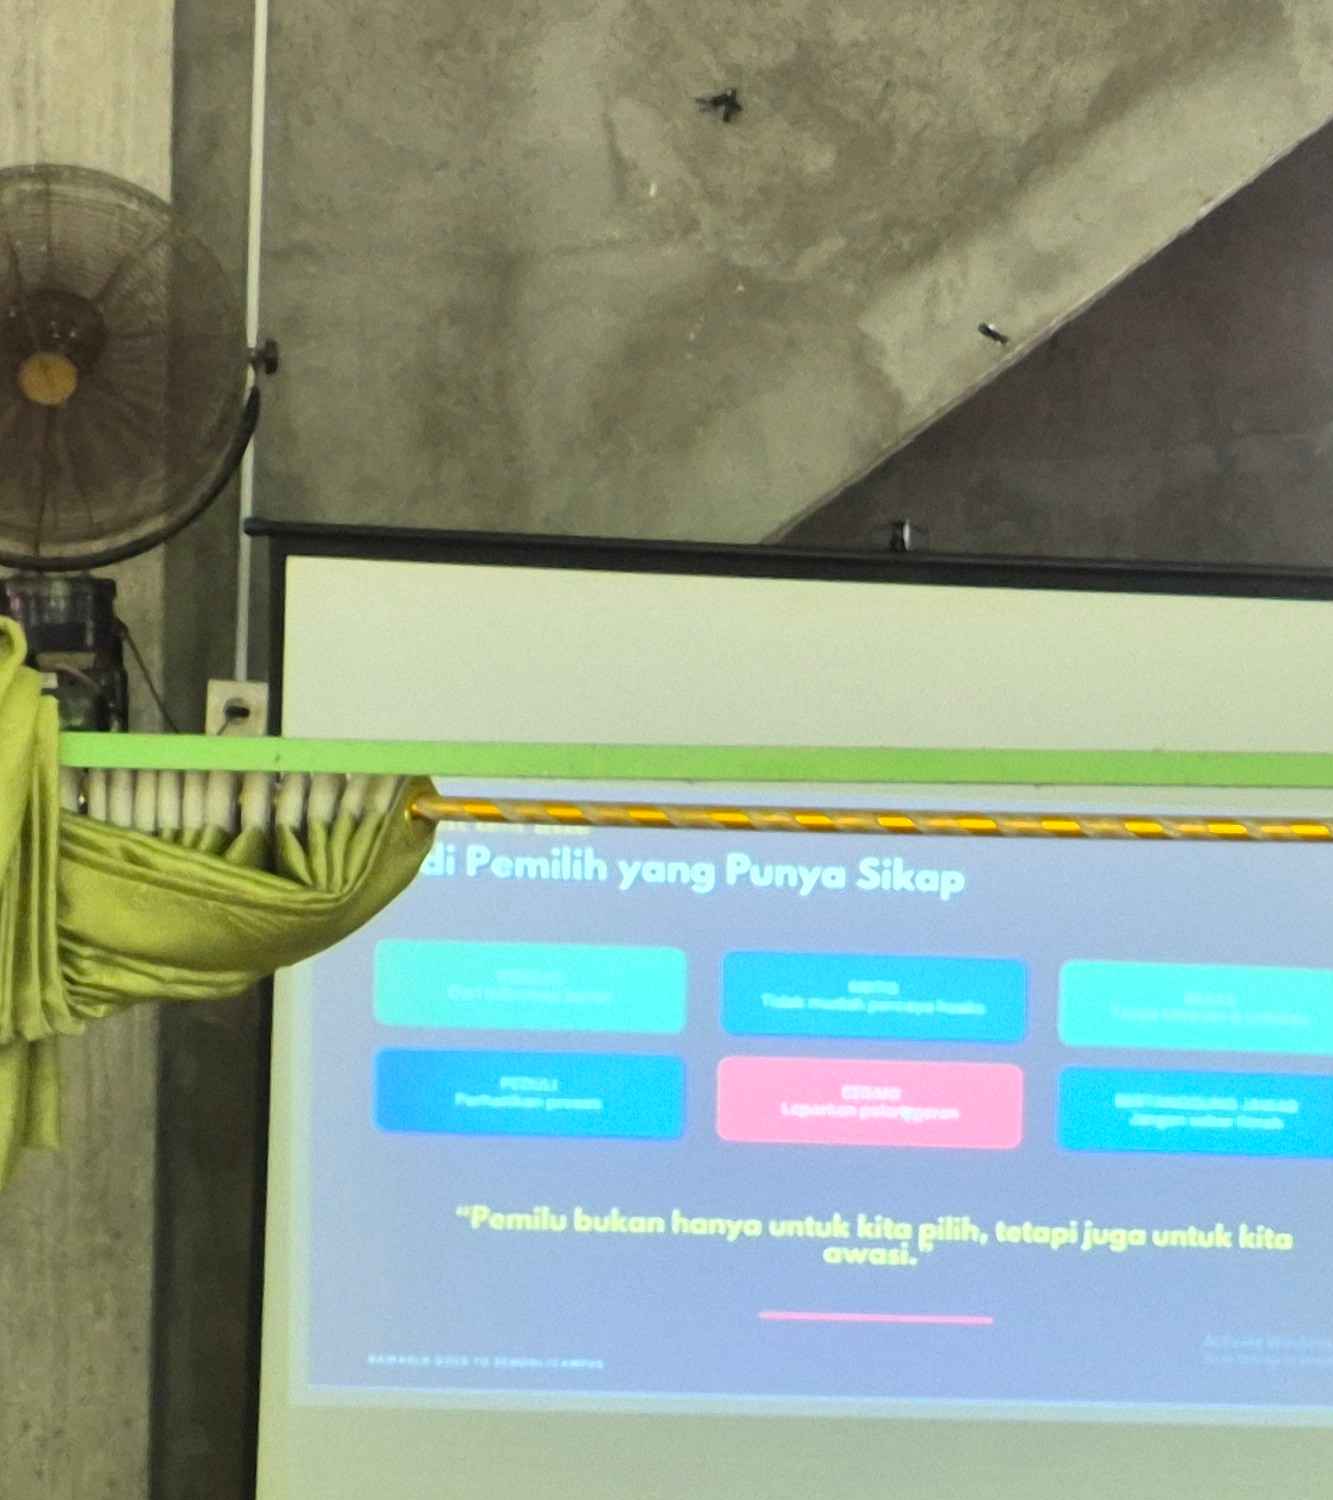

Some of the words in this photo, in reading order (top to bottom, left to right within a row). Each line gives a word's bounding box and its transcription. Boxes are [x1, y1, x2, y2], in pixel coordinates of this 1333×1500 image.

[421, 841, 457, 877] di
[466, 844, 608, 882] Pemilih
[617, 860, 716, 894] yang
[725, 852, 847, 897] Punya
[856, 855, 966, 902] Sikap
[573, 1205, 666, 1234] bukan
[671, 1208, 763, 1243] hanya
[768, 1211, 850, 1240] untuk
[857, 1212, 913, 1240] kita
[917, 1215, 989, 1252] pilih,
[995, 1219, 1078, 1251] tetapi
[1080, 1219, 1147, 1253] juga
[1152, 1222, 1233, 1249] untuk
[1238, 1222, 1294, 1251] kita
